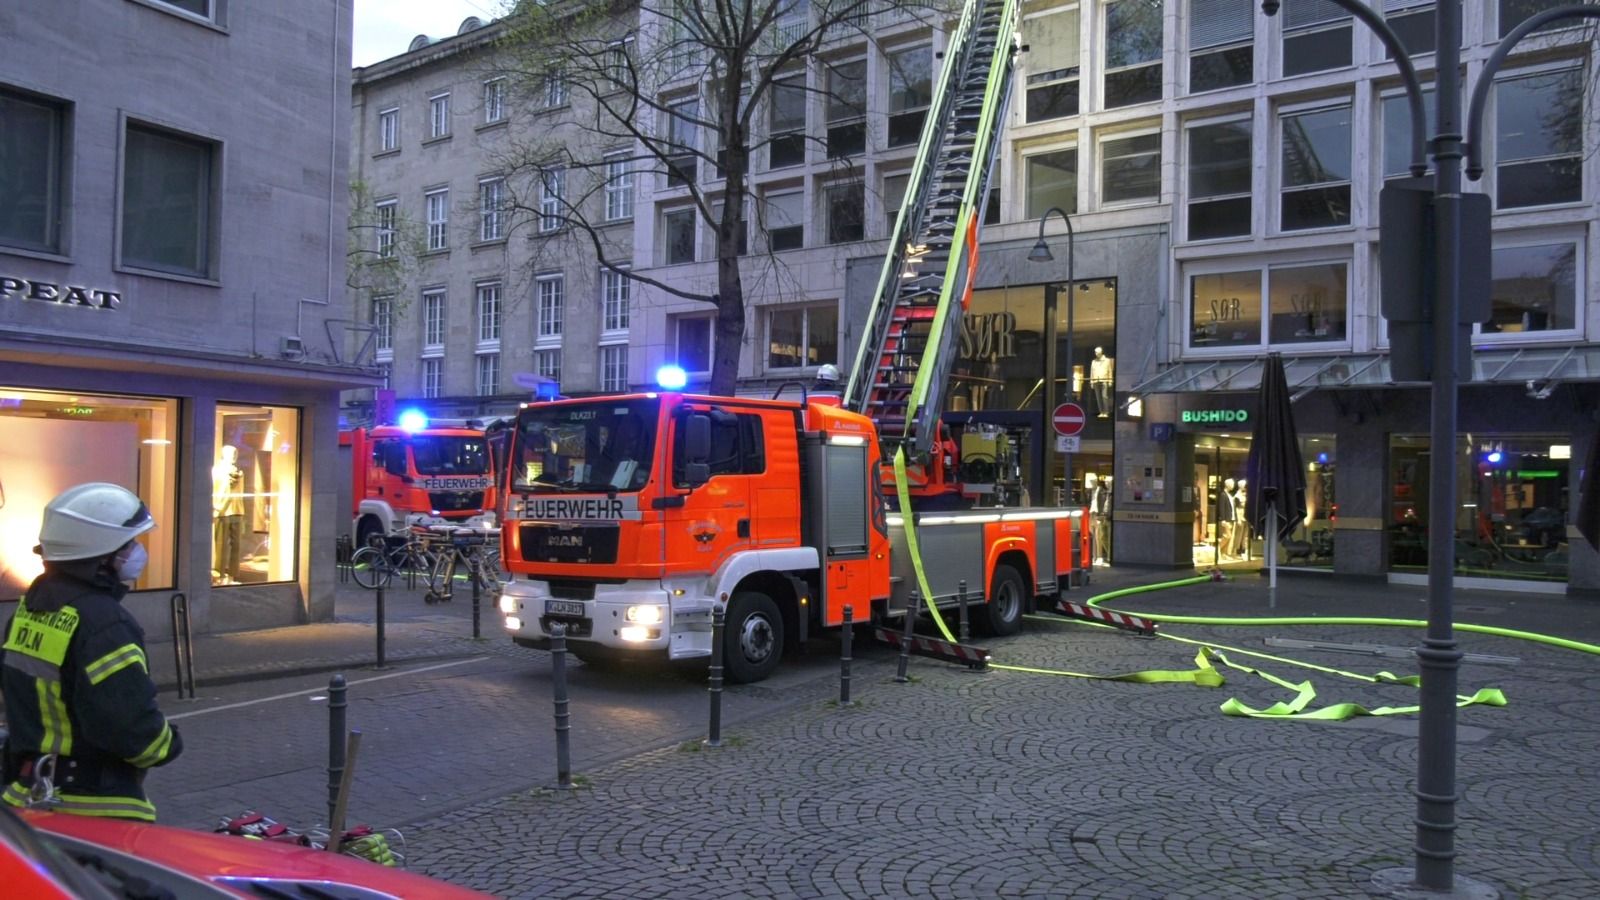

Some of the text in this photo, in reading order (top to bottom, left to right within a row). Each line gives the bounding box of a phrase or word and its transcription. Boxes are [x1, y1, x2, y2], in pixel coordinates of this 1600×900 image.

[0, 277, 121, 310] PEAT
[1181, 409, 1248, 422] BUSHIDO
[425, 478, 488, 489] FEUERWEHR
[515, 499, 624, 519] FEUERWEHR
[548, 535, 583, 546] MAN
